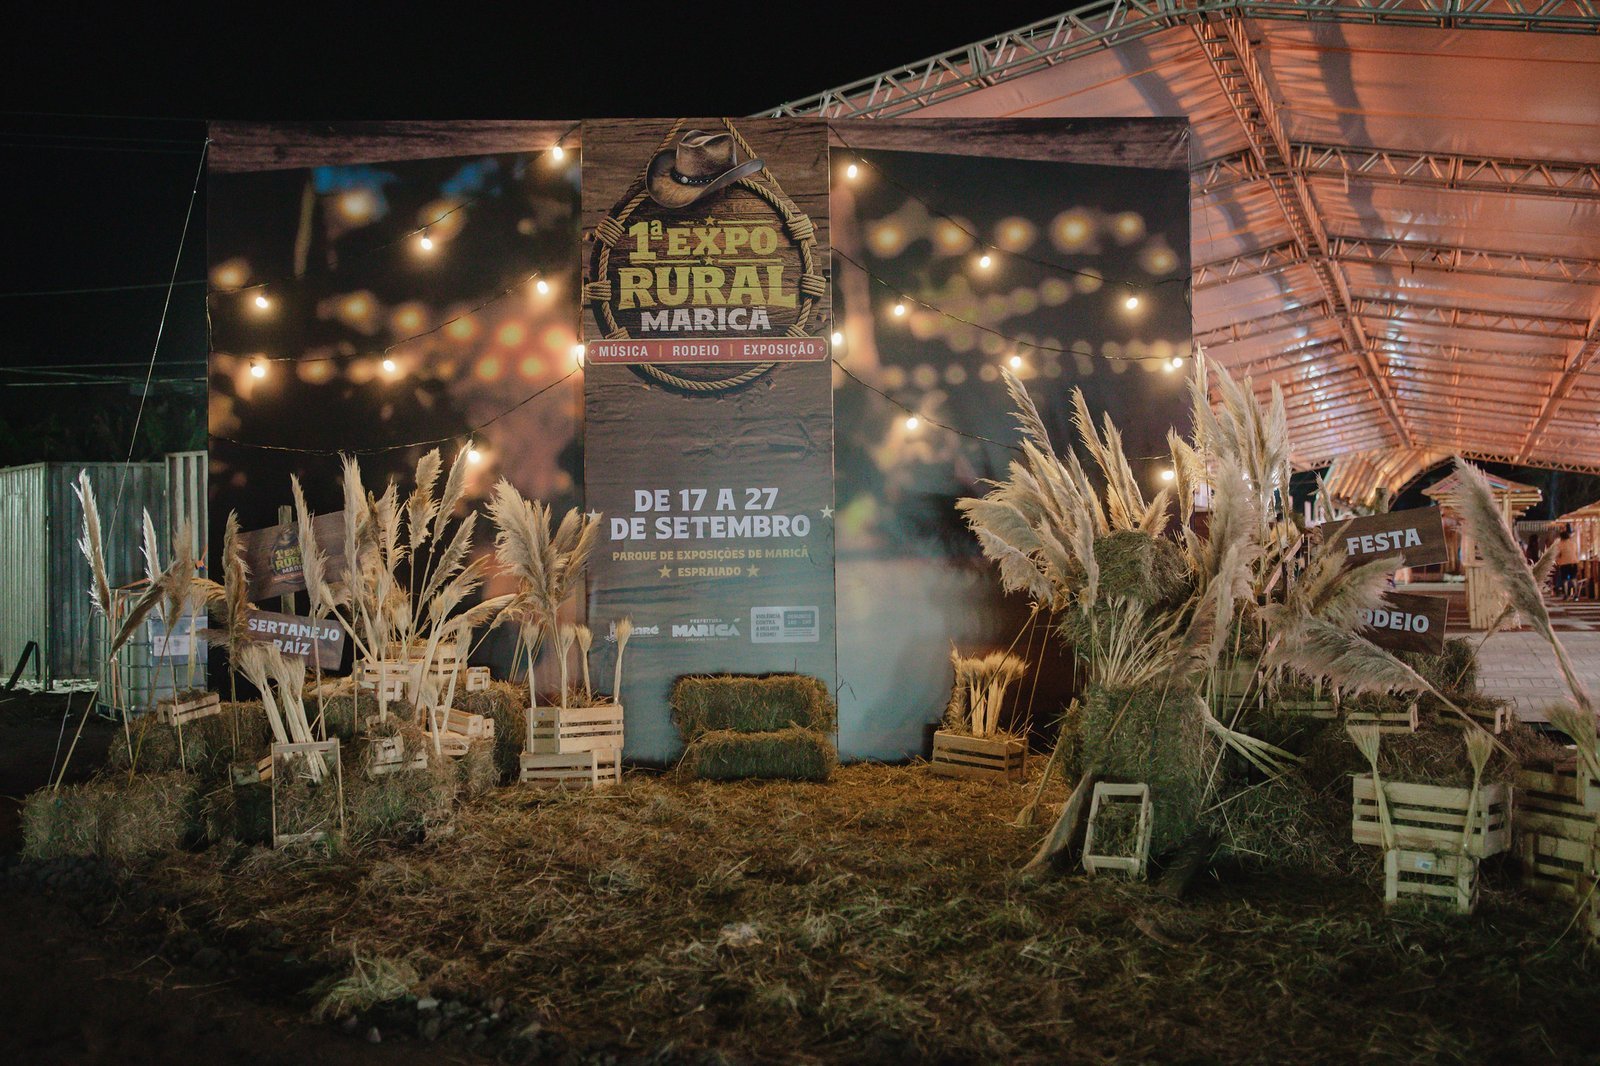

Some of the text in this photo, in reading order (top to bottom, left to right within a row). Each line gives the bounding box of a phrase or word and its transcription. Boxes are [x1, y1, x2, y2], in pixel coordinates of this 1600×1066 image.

[629, 219, 778, 260] 1ª EXPO
[618, 265, 796, 310] RURAL
[598, 341, 815, 359] MÚSICA RODEIO EXPOSIÇÃO
[634, 487, 779, 513] DE 17 A 27
[610, 514, 811, 541] DE SETEMBRO
[612, 545, 809, 562] PARQUE DE EXPOSIÇÕES DE MARICÁ
[1347, 528, 1422, 556] FESTA
[677, 566, 741, 577] ESPRAIADO
[247, 618, 340, 642] SERTANEJO
[672, 617, 741, 638] MARICÁ
[1359, 608, 1430, 633] ODEIO
